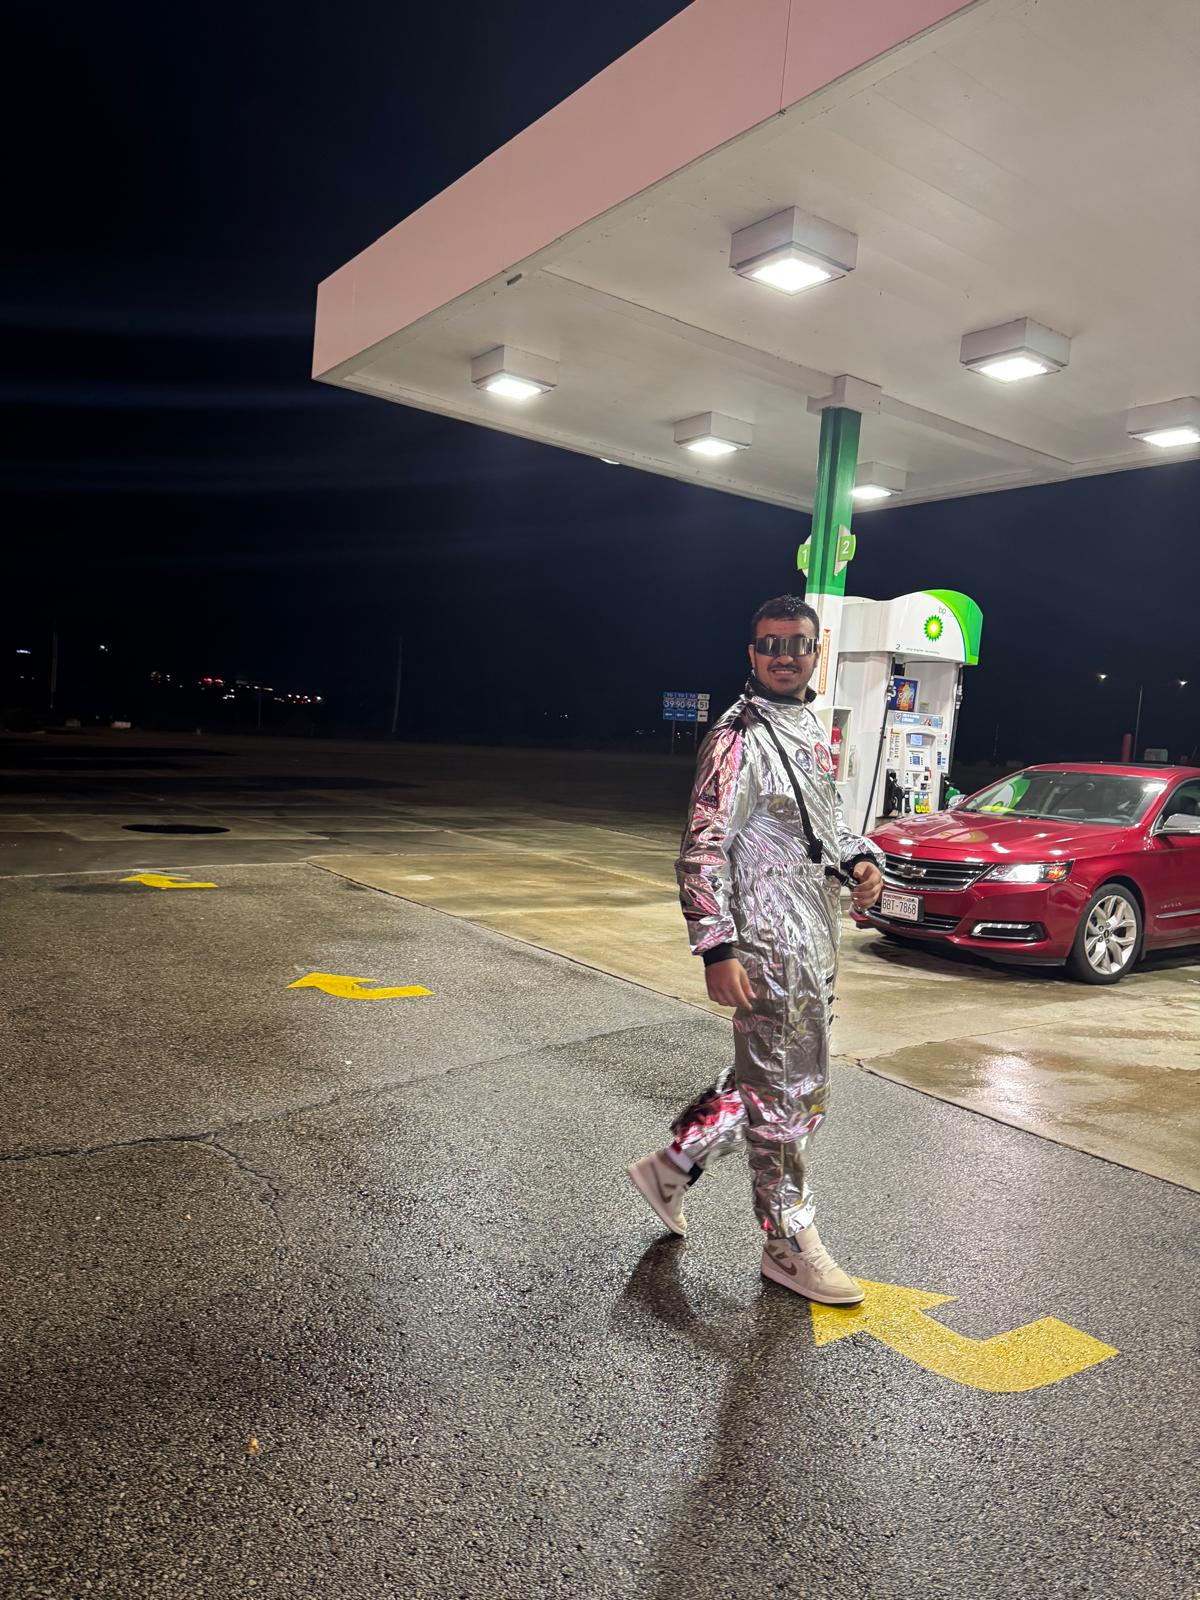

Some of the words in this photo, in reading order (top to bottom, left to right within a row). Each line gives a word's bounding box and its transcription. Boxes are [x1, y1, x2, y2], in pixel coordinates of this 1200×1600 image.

[842, 540, 850, 554] 2
[802, 549, 807, 563] 1
[938, 605, 946, 616] bp
